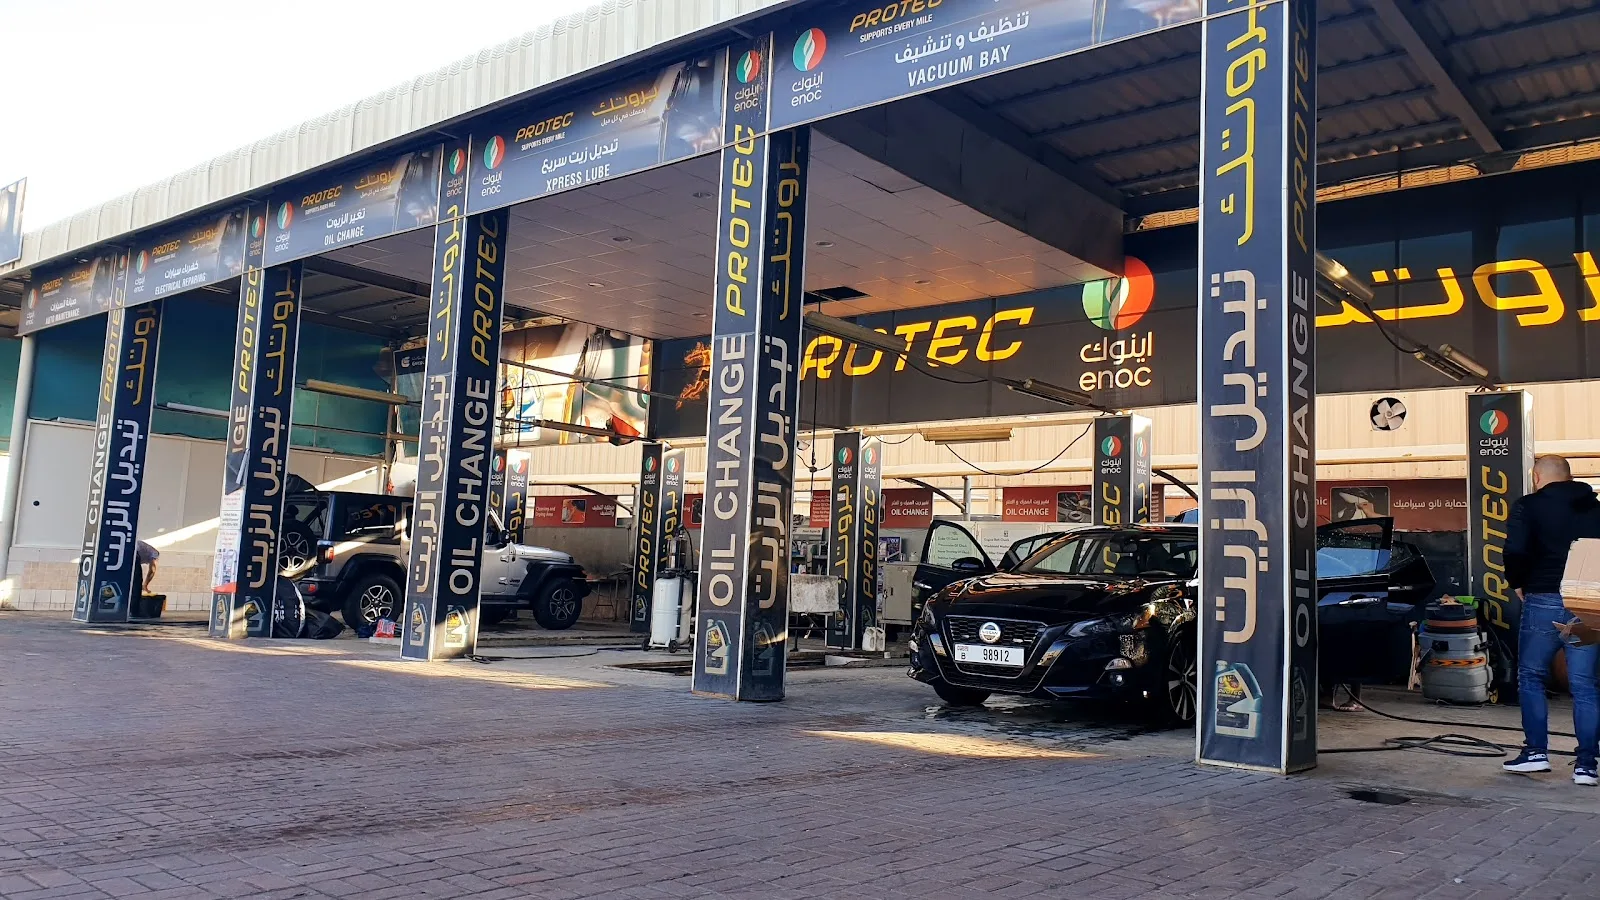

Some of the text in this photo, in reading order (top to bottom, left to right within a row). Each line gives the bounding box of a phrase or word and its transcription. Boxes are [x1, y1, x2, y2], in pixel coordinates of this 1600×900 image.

[859, 14, 933, 43] SUPPORTS EVERY MILE
[894, 10, 1030, 64] تنظيف و تنشيف
[907, 45, 1012, 87] VACUUM BAY
[791, 71, 824, 93] اينوك
[591, 85, 659, 117] بروتك
[733, 98, 760, 113] enoc
[790, 89, 823, 107] enoc
[515, 112, 574, 143] PROTEC
[521, 138, 541, 152] SUPPORTS
[541, 138, 619, 175] تبديل زيت سريع
[445, 186, 462, 198] enoc
[481, 184, 502, 197] enoc
[482, 171, 503, 186] اينوك
[546, 163, 611, 192] XPRESS LUBE
[301, 185, 343, 208] PROTEC
[151, 240, 181, 257] PROTEC
[274, 241, 290, 252] enoc
[324, 226, 365, 246] OIL CHANGE
[41, 277, 64, 292] PROTEC
[133, 285, 145, 294] enoc
[155, 272, 207, 295] ELECTRICAL REPAIRING
[55, 307, 80, 322] MAINTENANCE
[238, 264, 259, 394] PROTEC
[1292, 0, 1310, 648] OIL CHANGE PROTEC
[800, 306, 1035, 380] ROTEC
[1079, 332, 1154, 367] اينوك
[708, 124, 755, 607] OIL CHANGE PROTEC
[1210, 269, 1267, 452] تبديل
[1079, 365, 1153, 392] enoc
[448, 213, 499, 595] OIL CHANGE PROTEC
[760, 336, 792, 472] تبديل
[82, 287, 123, 577] OIL CHANGE PROTEC
[424, 375, 449, 482] تبديل
[1479, 437, 1509, 449] اينوك
[111, 419, 144, 495] تبديل
[253, 406, 286, 497] تبديل
[1101, 458, 1122, 468] اينوك
[1479, 448, 1509, 456] enoc
[1101, 466, 1122, 474] enoc
[890, 508, 929, 516] OIL CHANGE
[1005, 508, 1049, 516] OIL CHANGE
[1393, 499, 1426, 509] سيراميك
[1428, 499, 1442, 510] نانو
[103, 500, 132, 571] الزيت
[246, 503, 275, 588] الزيت
[414, 492, 438, 593] الزيت
[637, 490, 655, 589] PROTEC
[754, 483, 784, 609] الزيت
[862, 484, 877, 598] PROTEC
[1482, 465, 1510, 630] PROTEC
[1210, 470, 1269, 644] الزيت
[961, 648, 1010, 663] B 98912
